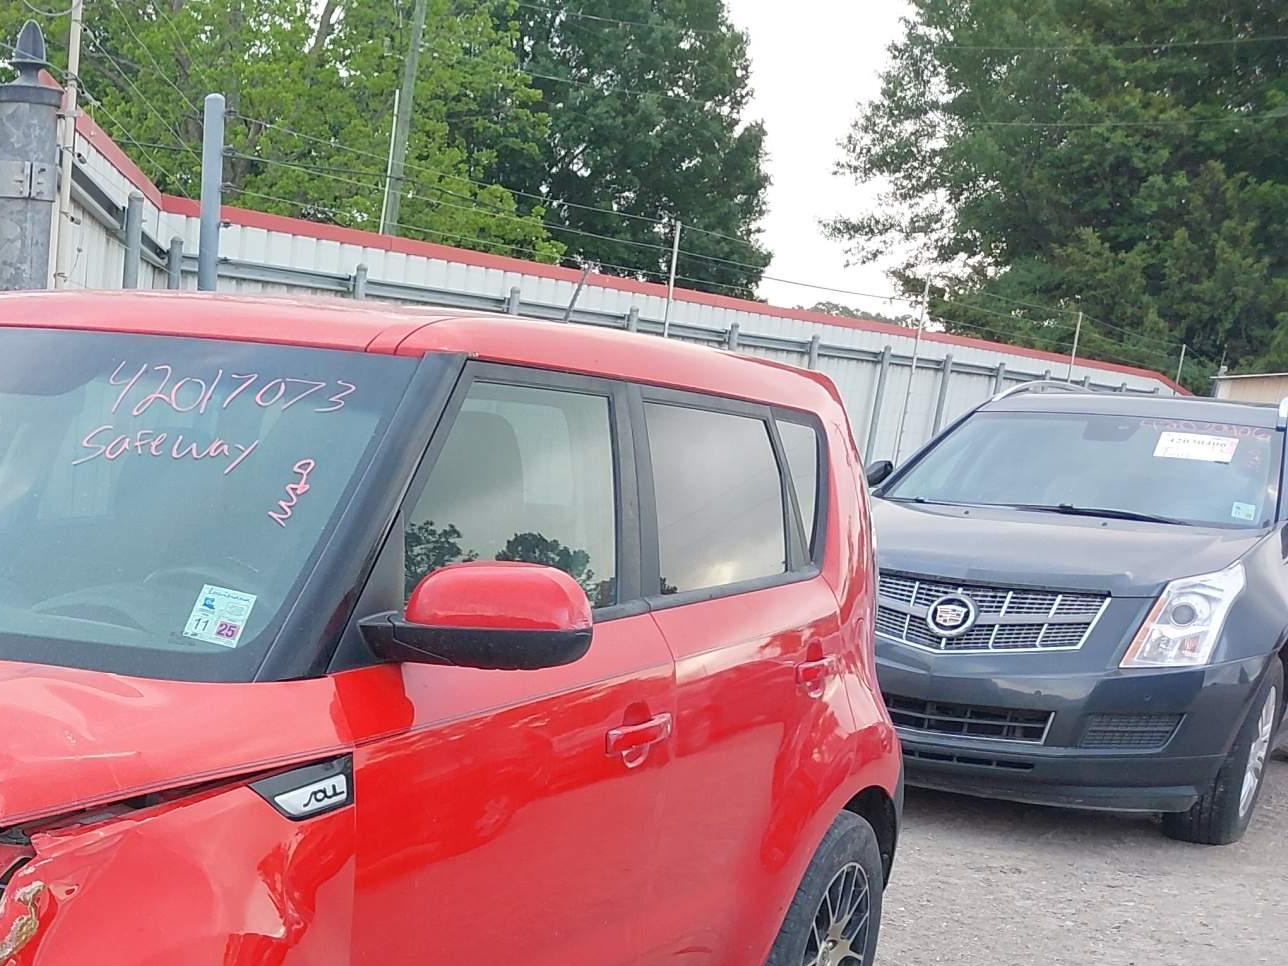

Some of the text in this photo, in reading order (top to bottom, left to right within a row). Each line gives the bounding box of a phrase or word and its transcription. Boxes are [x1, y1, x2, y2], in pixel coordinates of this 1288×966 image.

[109, 360, 357, 415] 42017073
[193, 617, 210, 632] 11
[215, 623, 238, 638] 25
